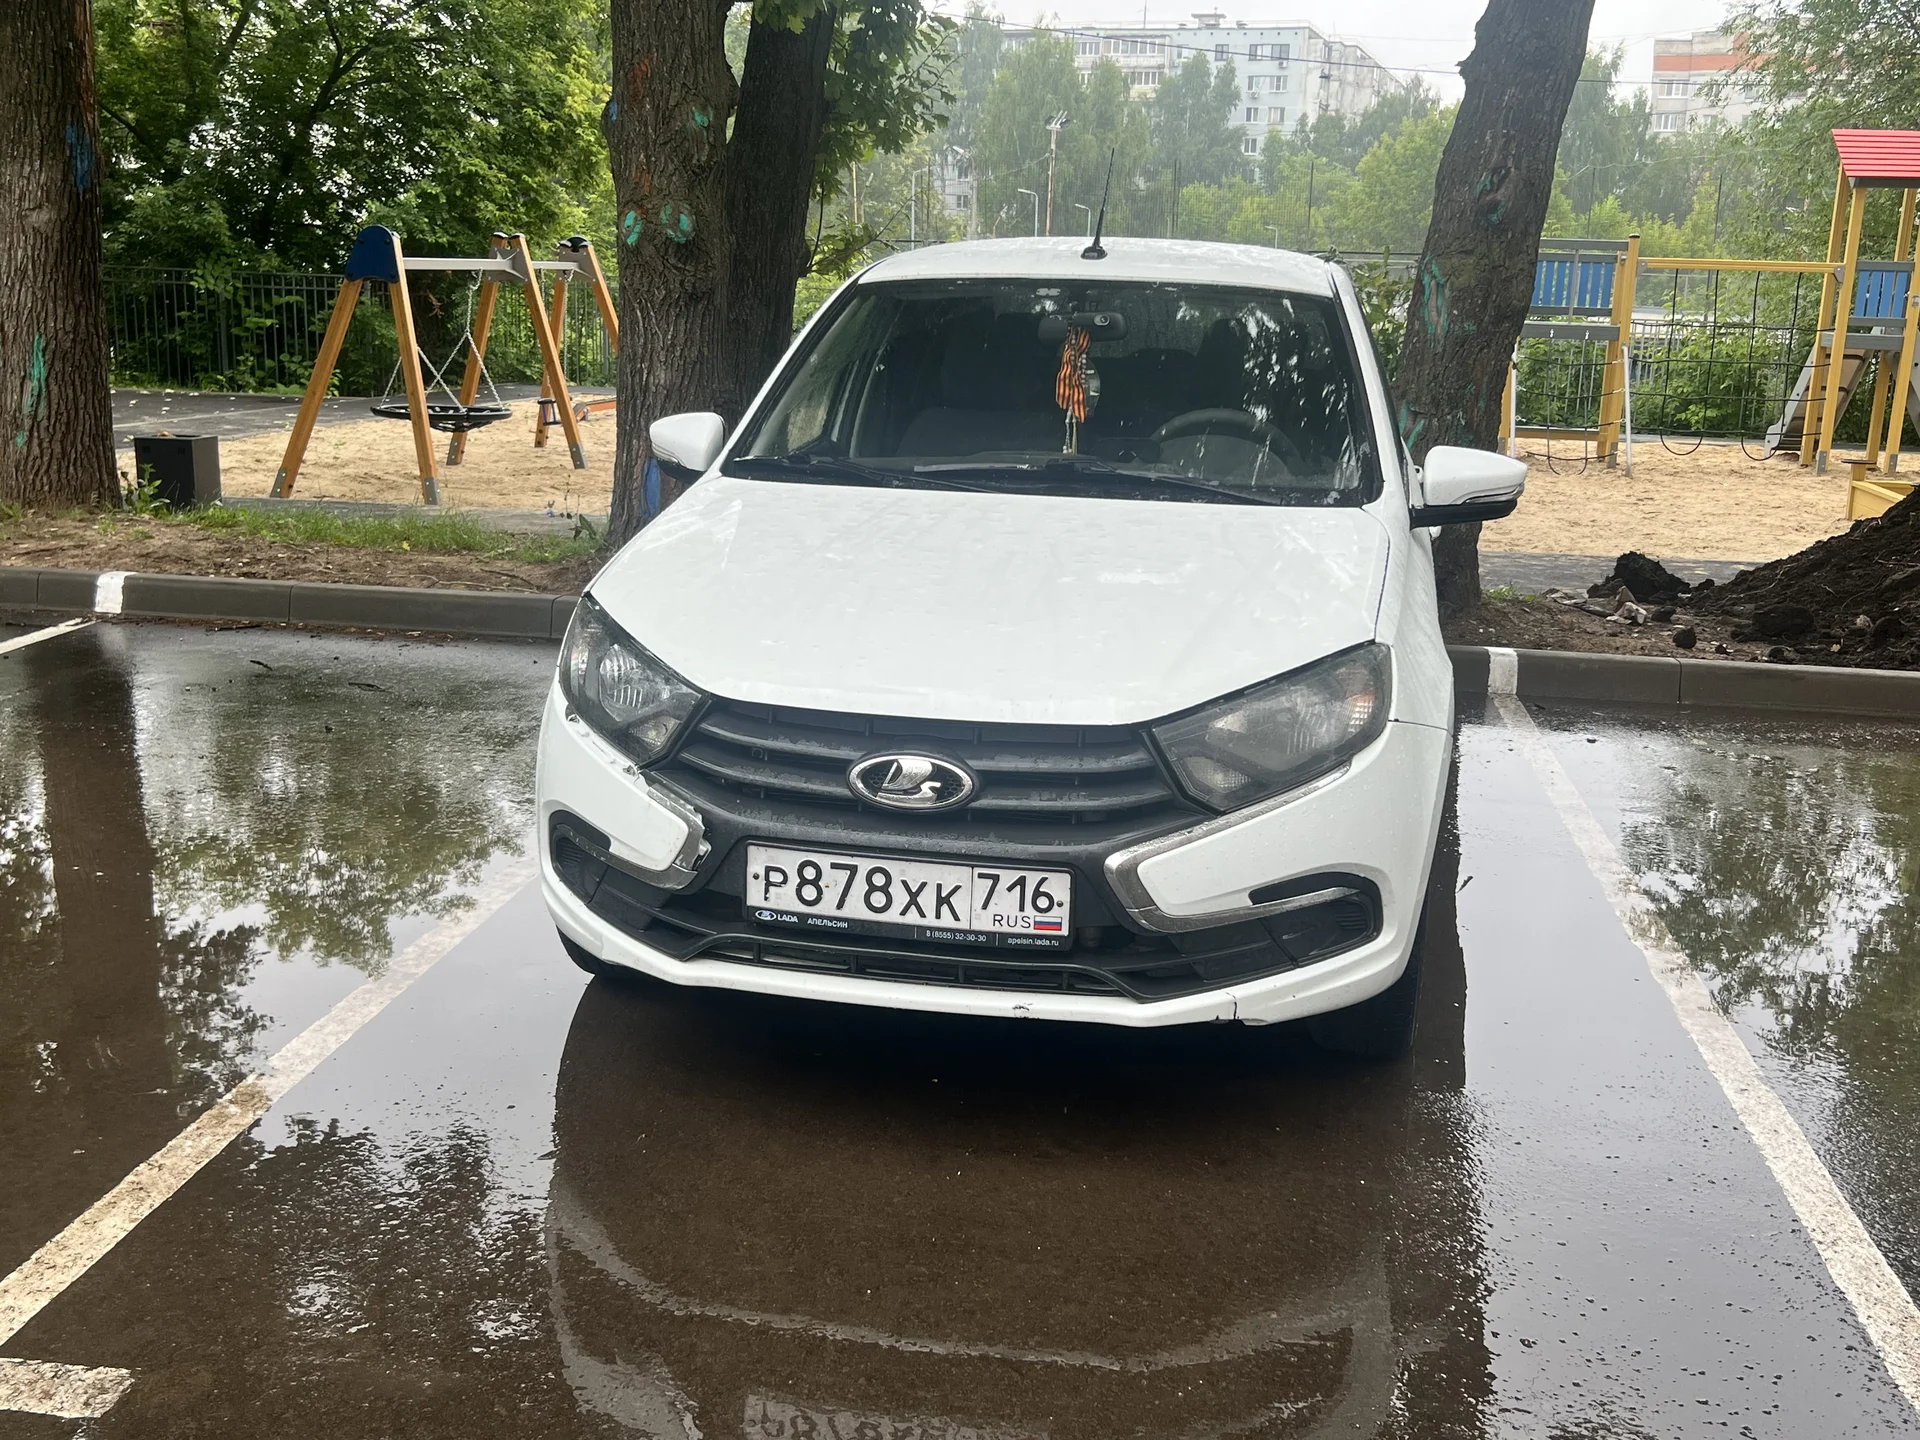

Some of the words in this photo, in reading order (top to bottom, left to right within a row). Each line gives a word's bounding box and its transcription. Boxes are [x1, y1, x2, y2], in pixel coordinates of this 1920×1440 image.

[977, 872, 1055, 914] 716
[777, 914, 799, 923] LADA
[807, 917, 848, 929] АПЕЛЬСИН
[993, 914, 1031, 929] RUS
[955, 932, 987, 942] 32-30-30
[1007, 937, 1059, 946] apelsin.lada.ru
